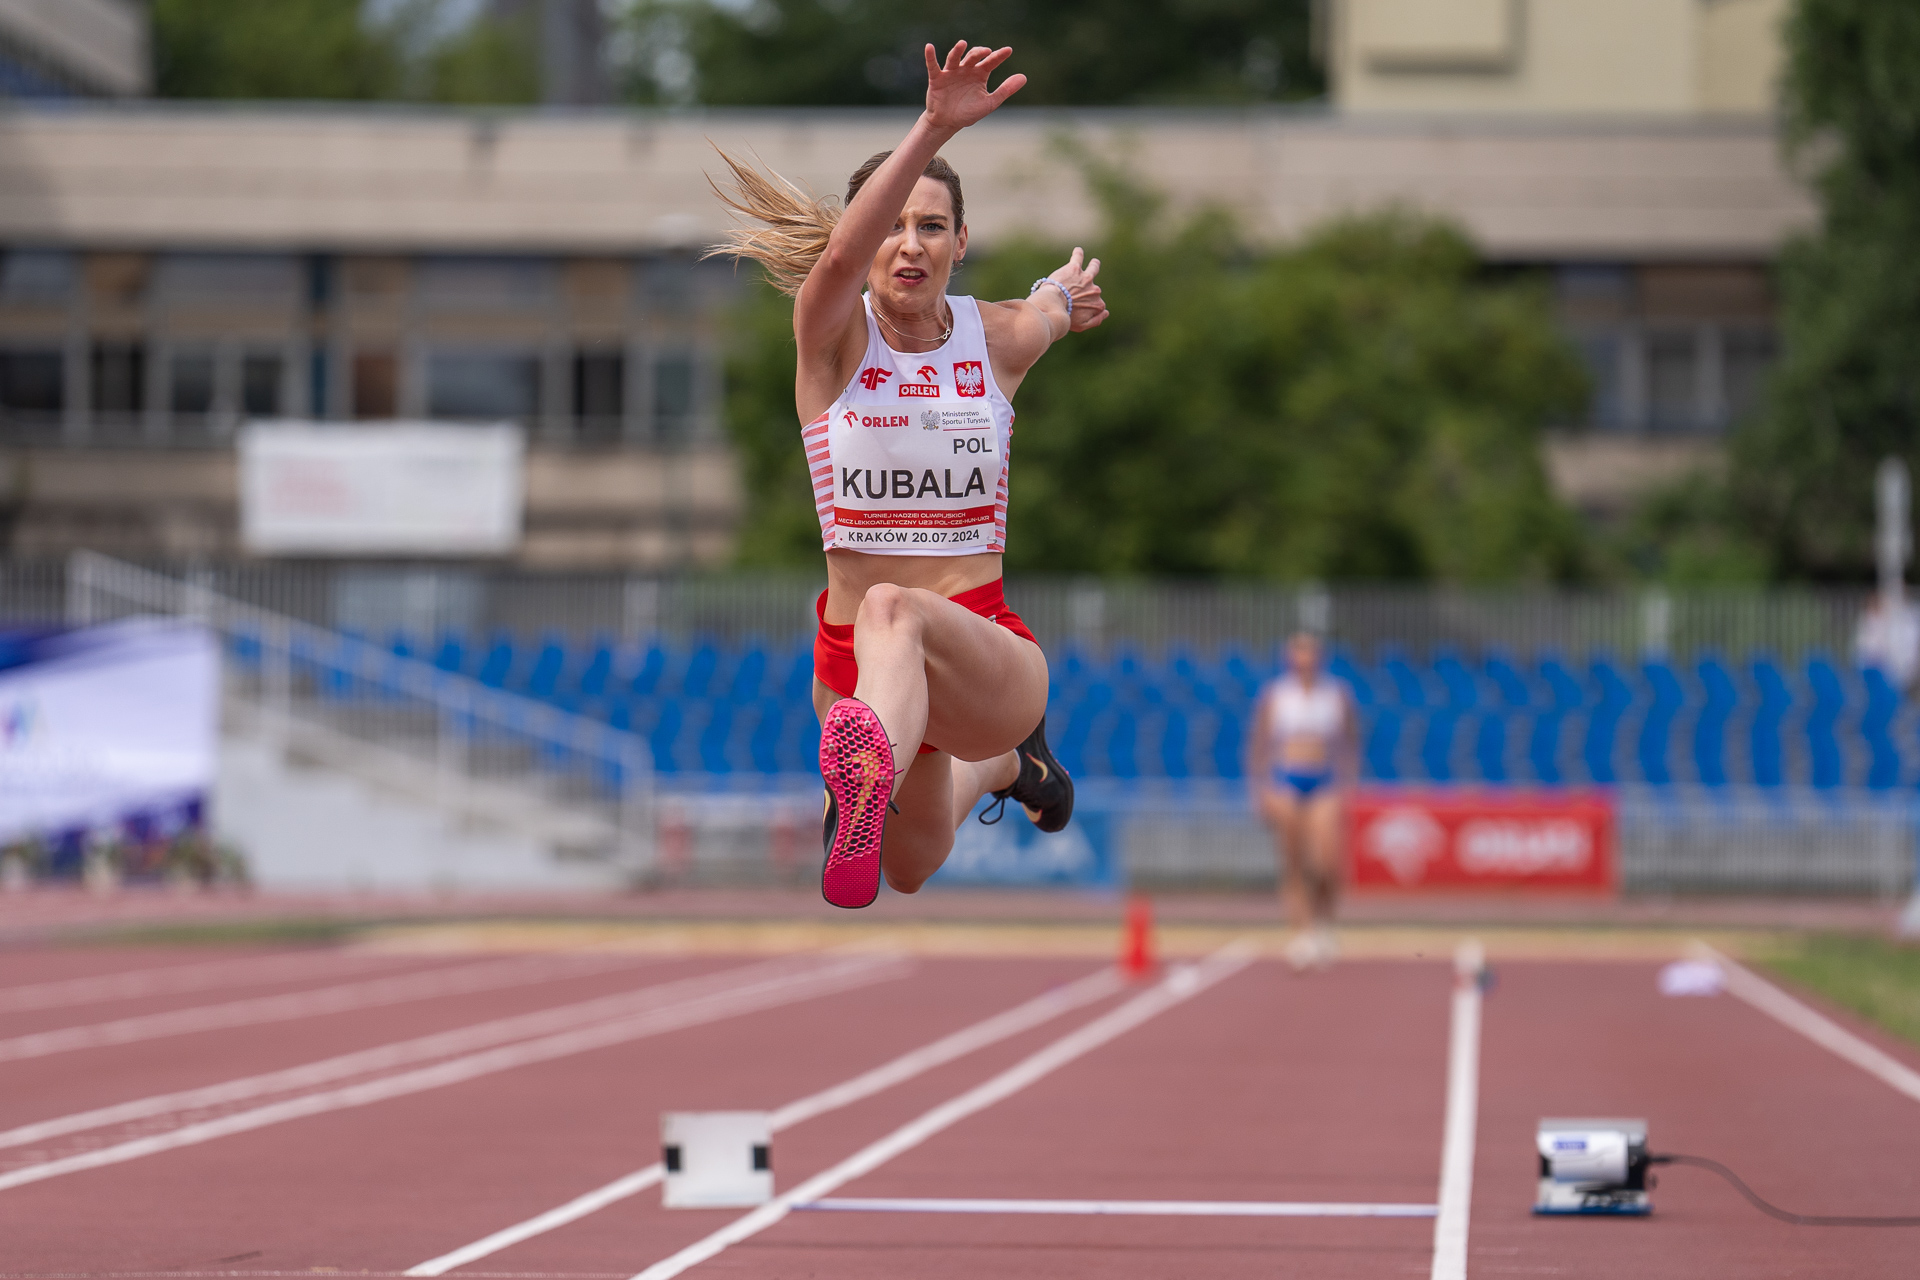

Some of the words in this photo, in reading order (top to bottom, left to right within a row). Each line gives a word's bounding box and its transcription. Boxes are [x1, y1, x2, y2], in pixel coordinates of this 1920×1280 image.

[901, 385, 938, 396] ORLEN
[862, 415, 909, 428] ORLEN
[942, 418, 962, 426] Sportu
[953, 437, 993, 455] POL
[842, 467, 986, 499] KUBALA
[837, 517, 854, 525] MECZ
[934, 515, 990, 526] POL-CZE-HUN-UKR
[848, 529, 908, 543] KRAKÓW
[911, 529, 980, 543] 20.07.2024
